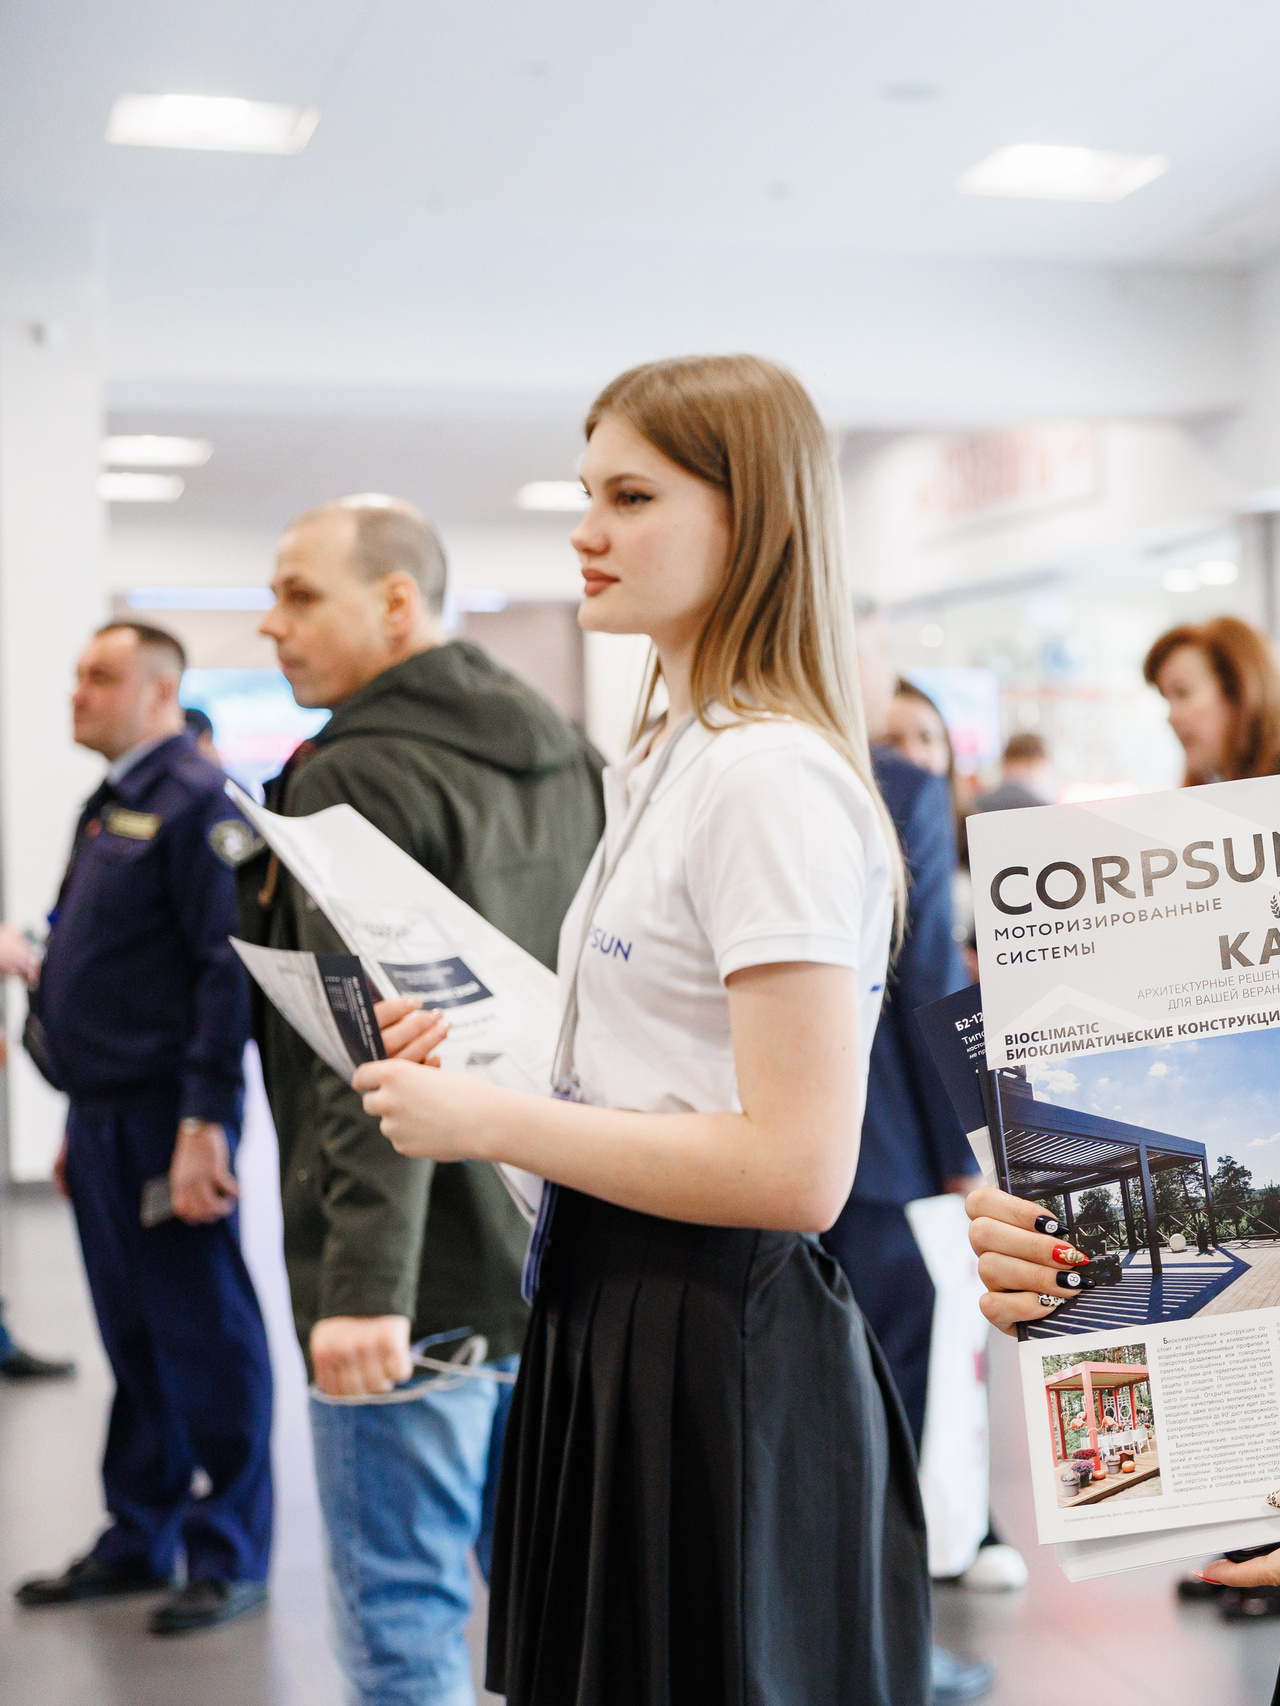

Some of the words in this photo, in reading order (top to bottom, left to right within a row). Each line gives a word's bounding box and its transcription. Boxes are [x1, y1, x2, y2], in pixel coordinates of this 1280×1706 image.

[994, 897, 1221, 943] МОТОРИЗИРОВАННЫЕ
[995, 939, 1095, 967] СИСТЕМЫ
[1137, 974, 1235, 1000] АРХИТЕКТУРНЫЕ
[1167, 996, 1191, 1010] ДЛЯ
[1195, 987, 1238, 1006] ВАШЕЙ
[1004, 1021, 1099, 1046] BIOCLIMATIC
[1005, 1025, 1173, 1061] БИОКЛИМАТИЧЕСКИЕ
